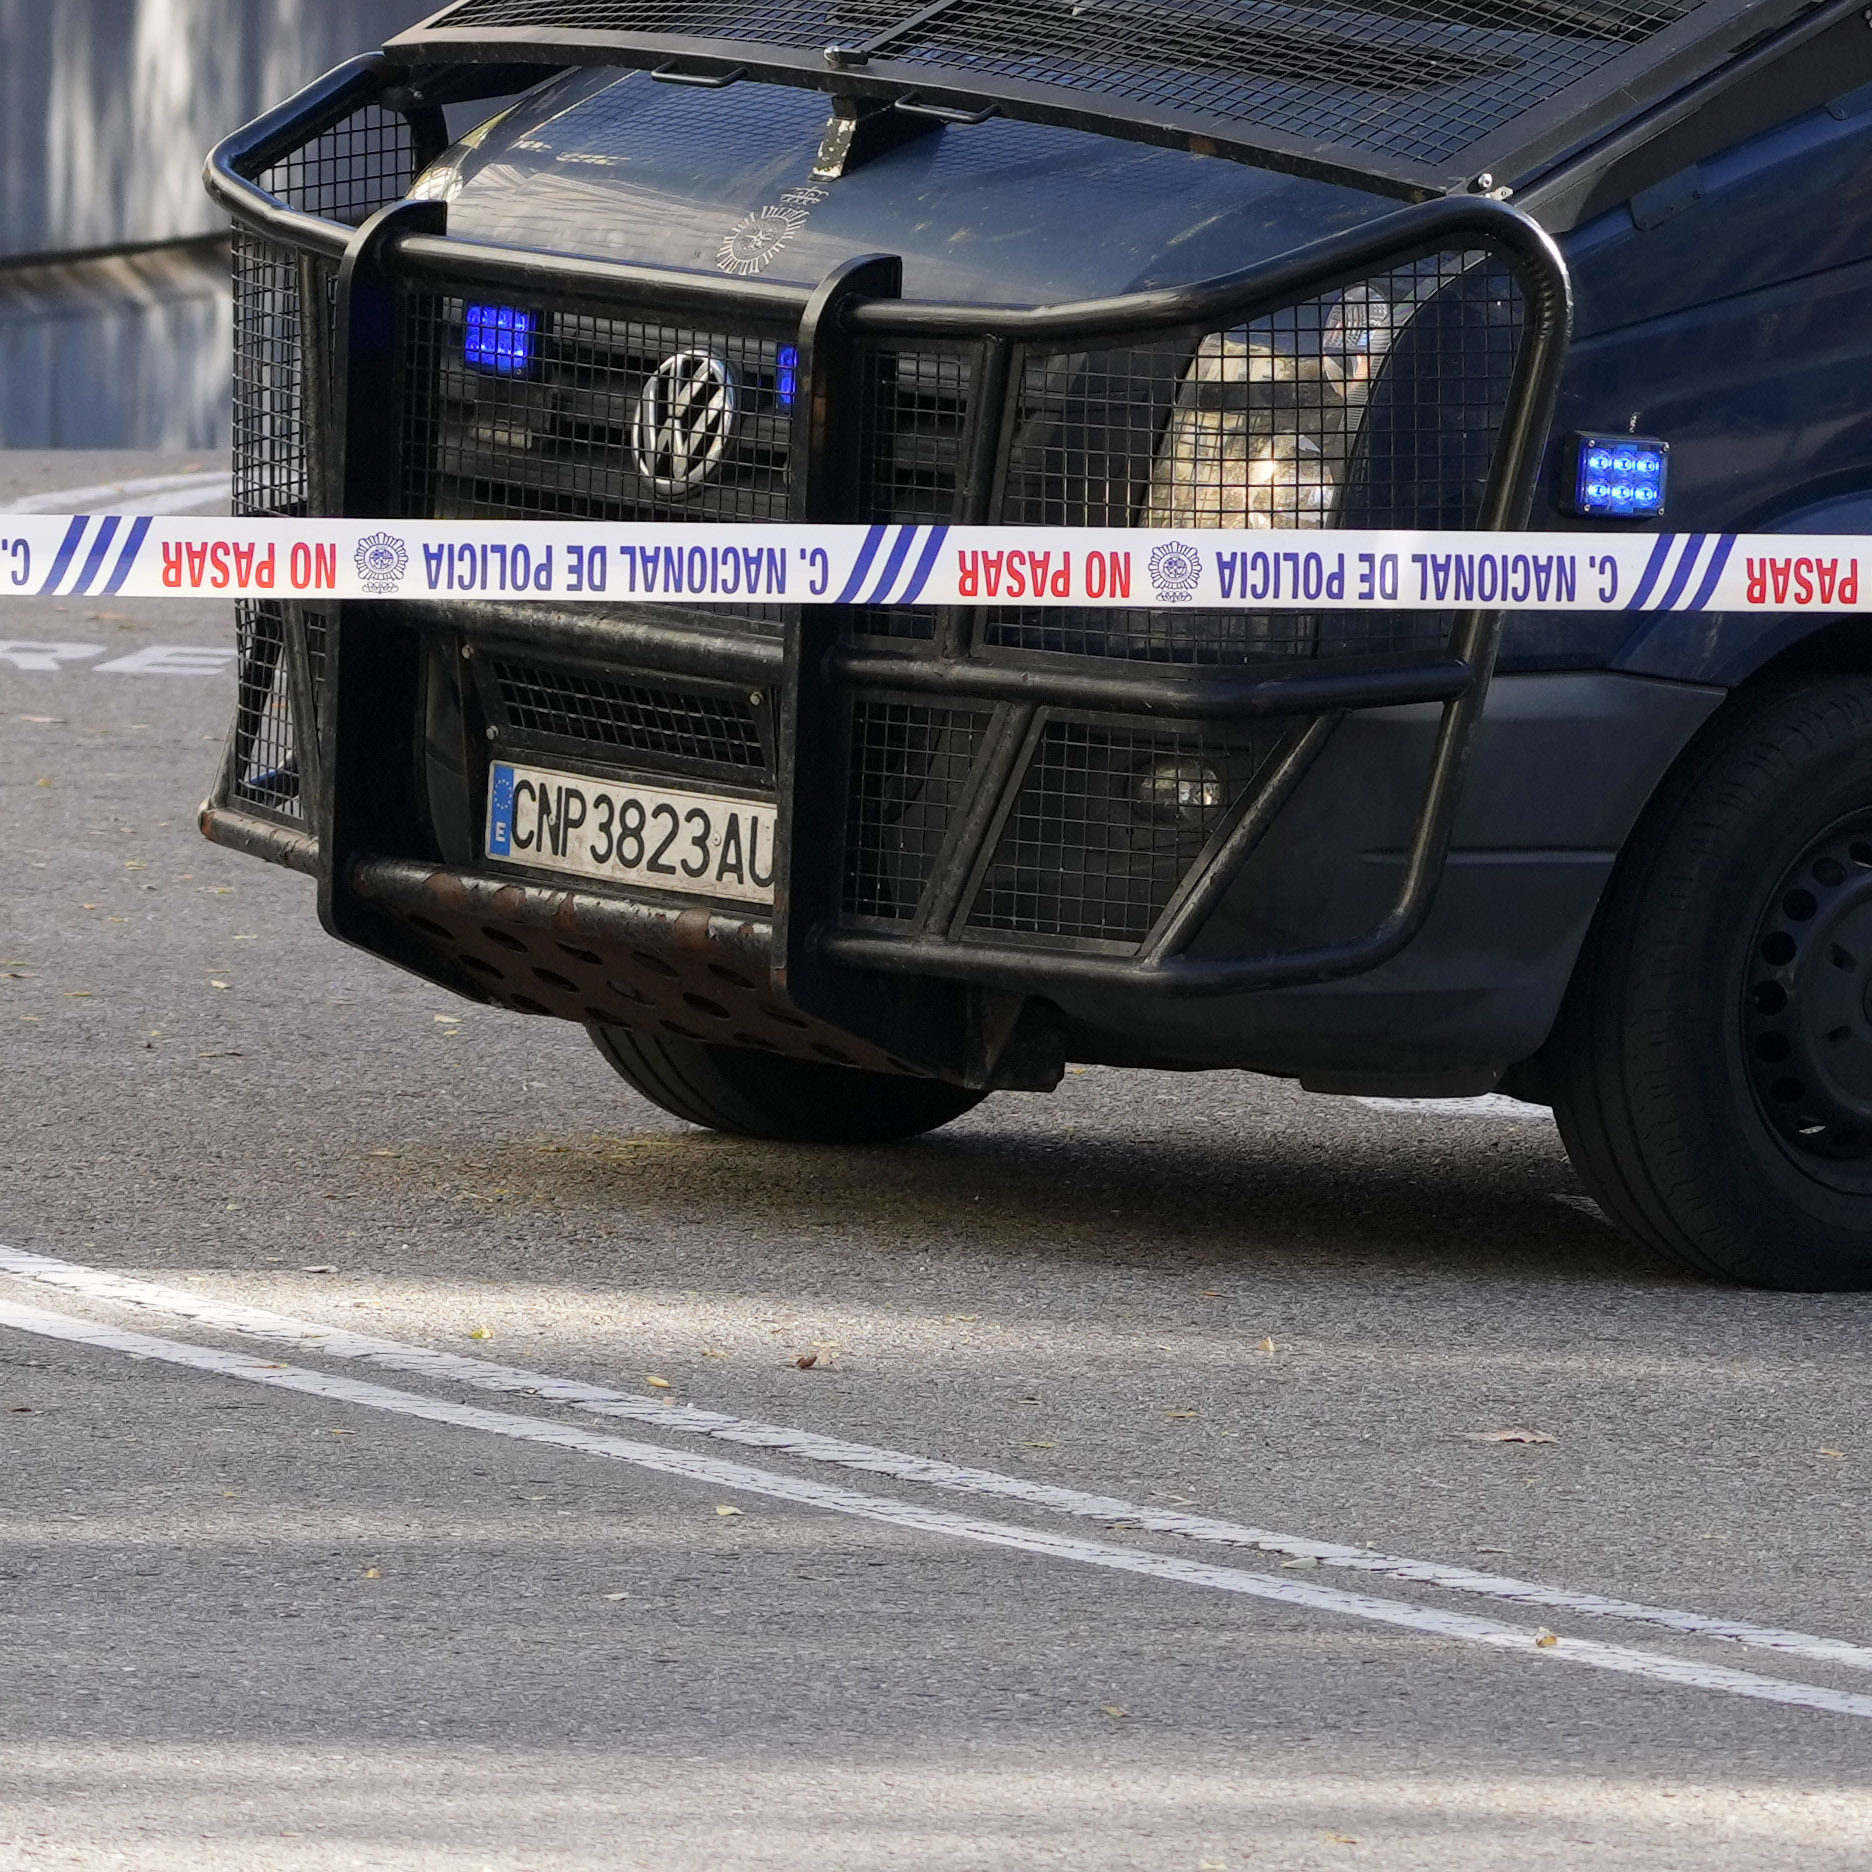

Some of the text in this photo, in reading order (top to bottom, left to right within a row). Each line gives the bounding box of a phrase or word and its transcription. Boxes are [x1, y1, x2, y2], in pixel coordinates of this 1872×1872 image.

[2, 538, 31, 587] C.
[162, 541, 337, 589] NO PASAR
[423, 543, 829, 593] C. NACIONAL DE POLICIA
[958, 550, 1131, 599] NO PASAR
[1215, 551, 1618, 602] C. NACIONAL DE POLICIA
[1746, 558, 1859, 605] PASAR
[494, 821, 507, 843] E
